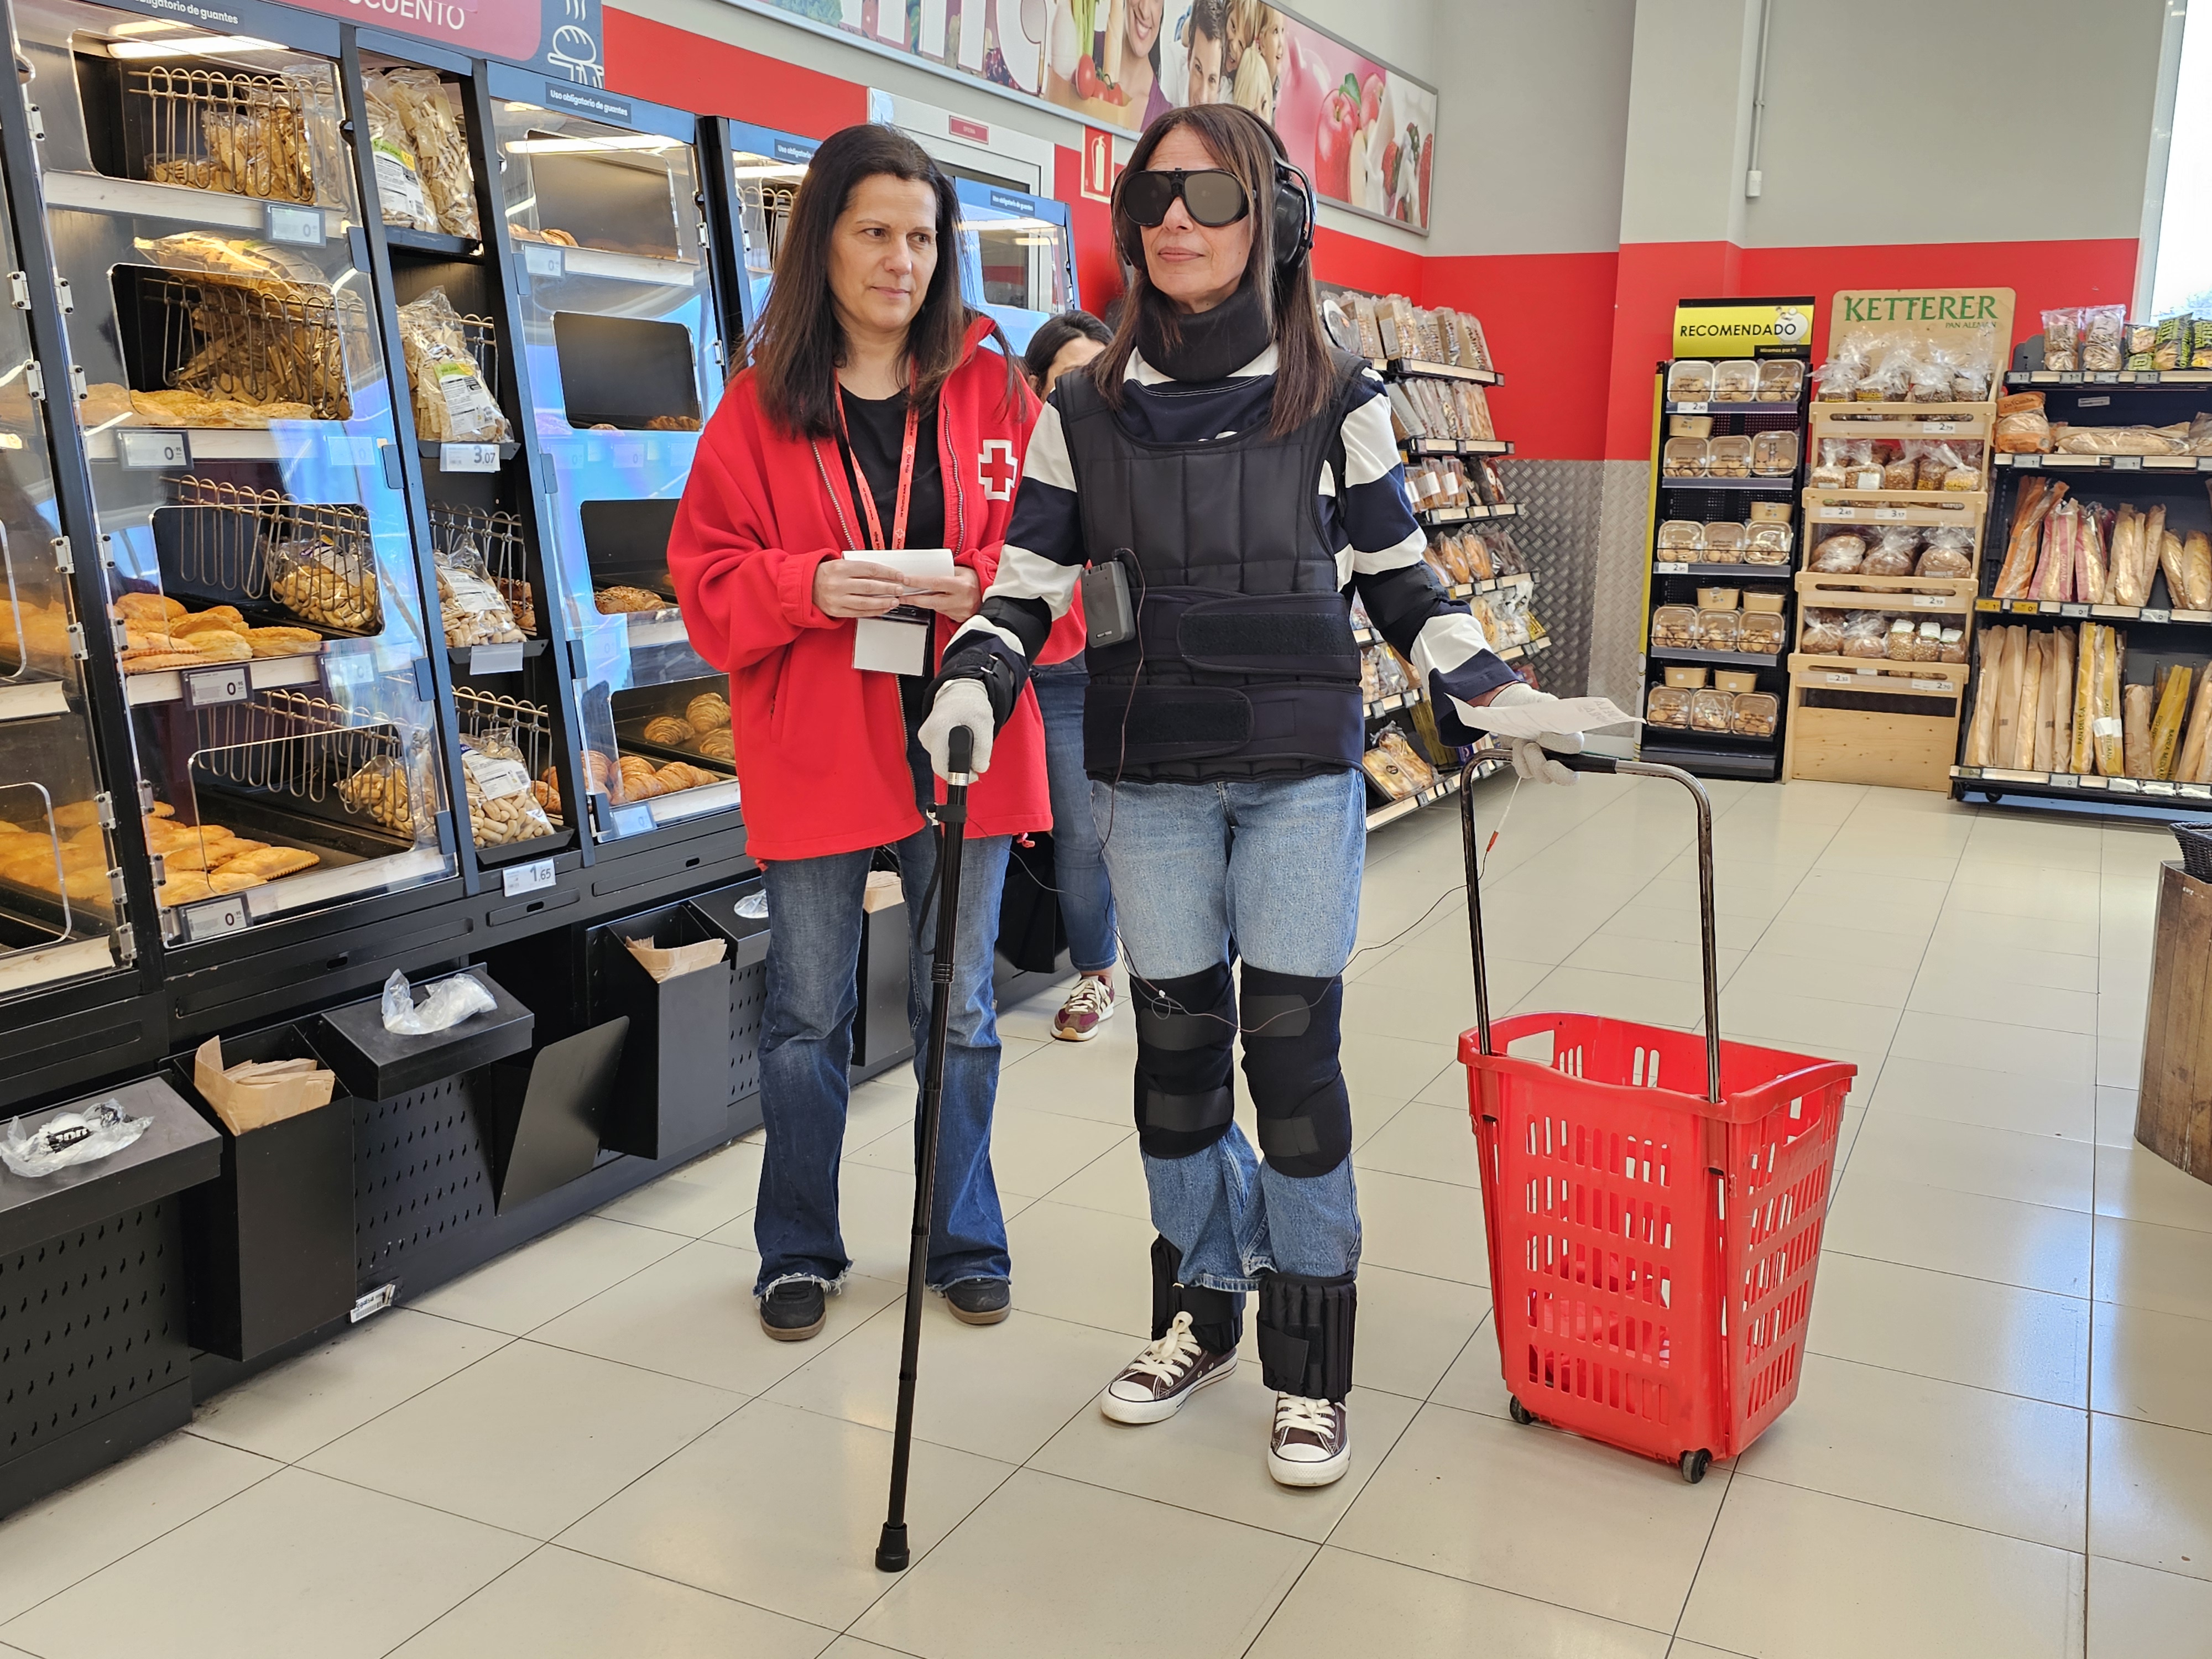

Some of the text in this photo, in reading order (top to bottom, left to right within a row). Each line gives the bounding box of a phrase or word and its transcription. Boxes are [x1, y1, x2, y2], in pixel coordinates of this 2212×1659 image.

[135, 0, 239, 24] ligatorio de guantes
[339, 0, 465, 30] UENTO
[550, 90, 628, 116] Uso obligatorio de guantes
[1844, 296, 1998, 321] KETTERER
[1680, 324, 1796, 337] RECOMENDADO
[474, 445, 495, 464] 3,07
[530, 865, 551, 882] 1,65
